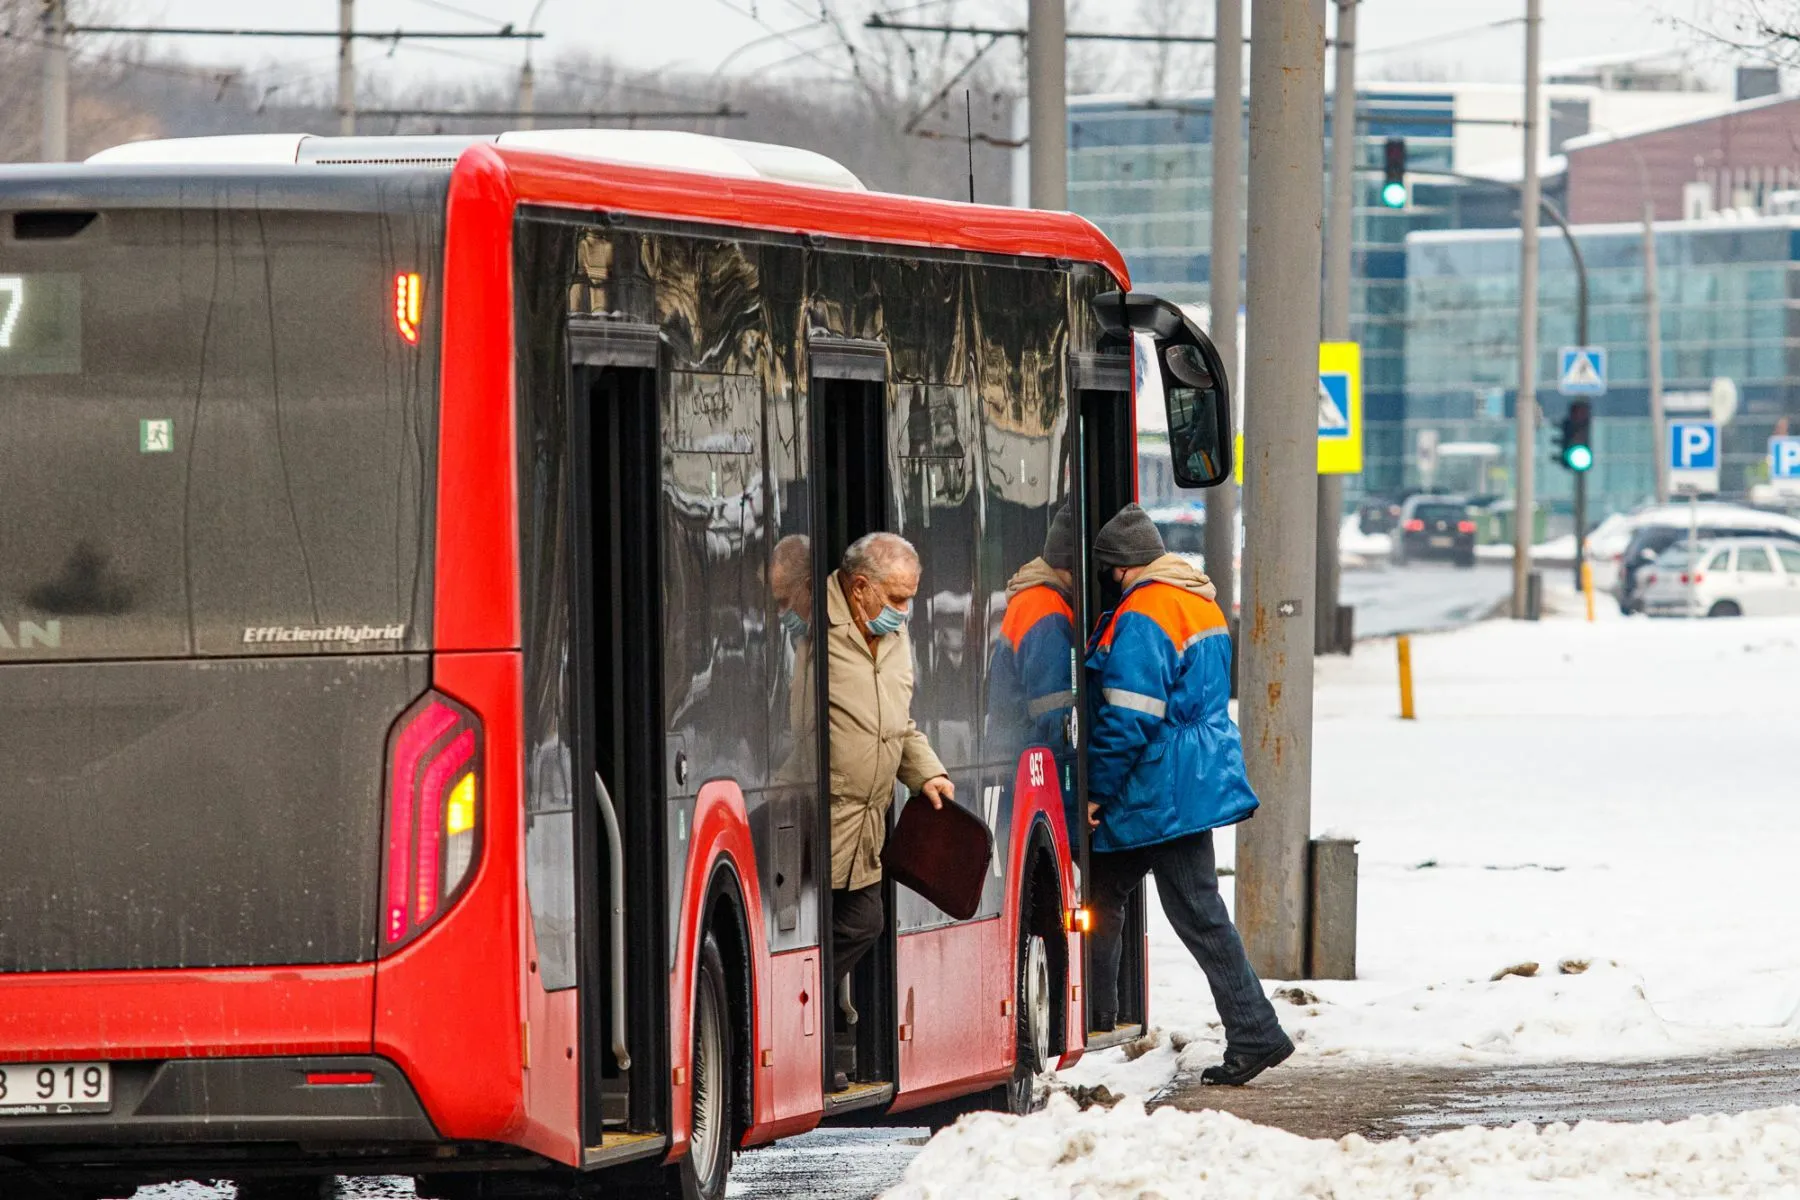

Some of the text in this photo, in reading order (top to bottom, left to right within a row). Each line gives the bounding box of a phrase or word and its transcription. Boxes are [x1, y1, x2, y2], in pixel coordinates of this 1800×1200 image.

[1680, 426, 1712, 467] P
[1780, 441, 1800, 476] P
[243, 623, 405, 643] EfficientHybrid
[1030, 752, 1044, 787] 953
[36, 1066, 102, 1099] 919
